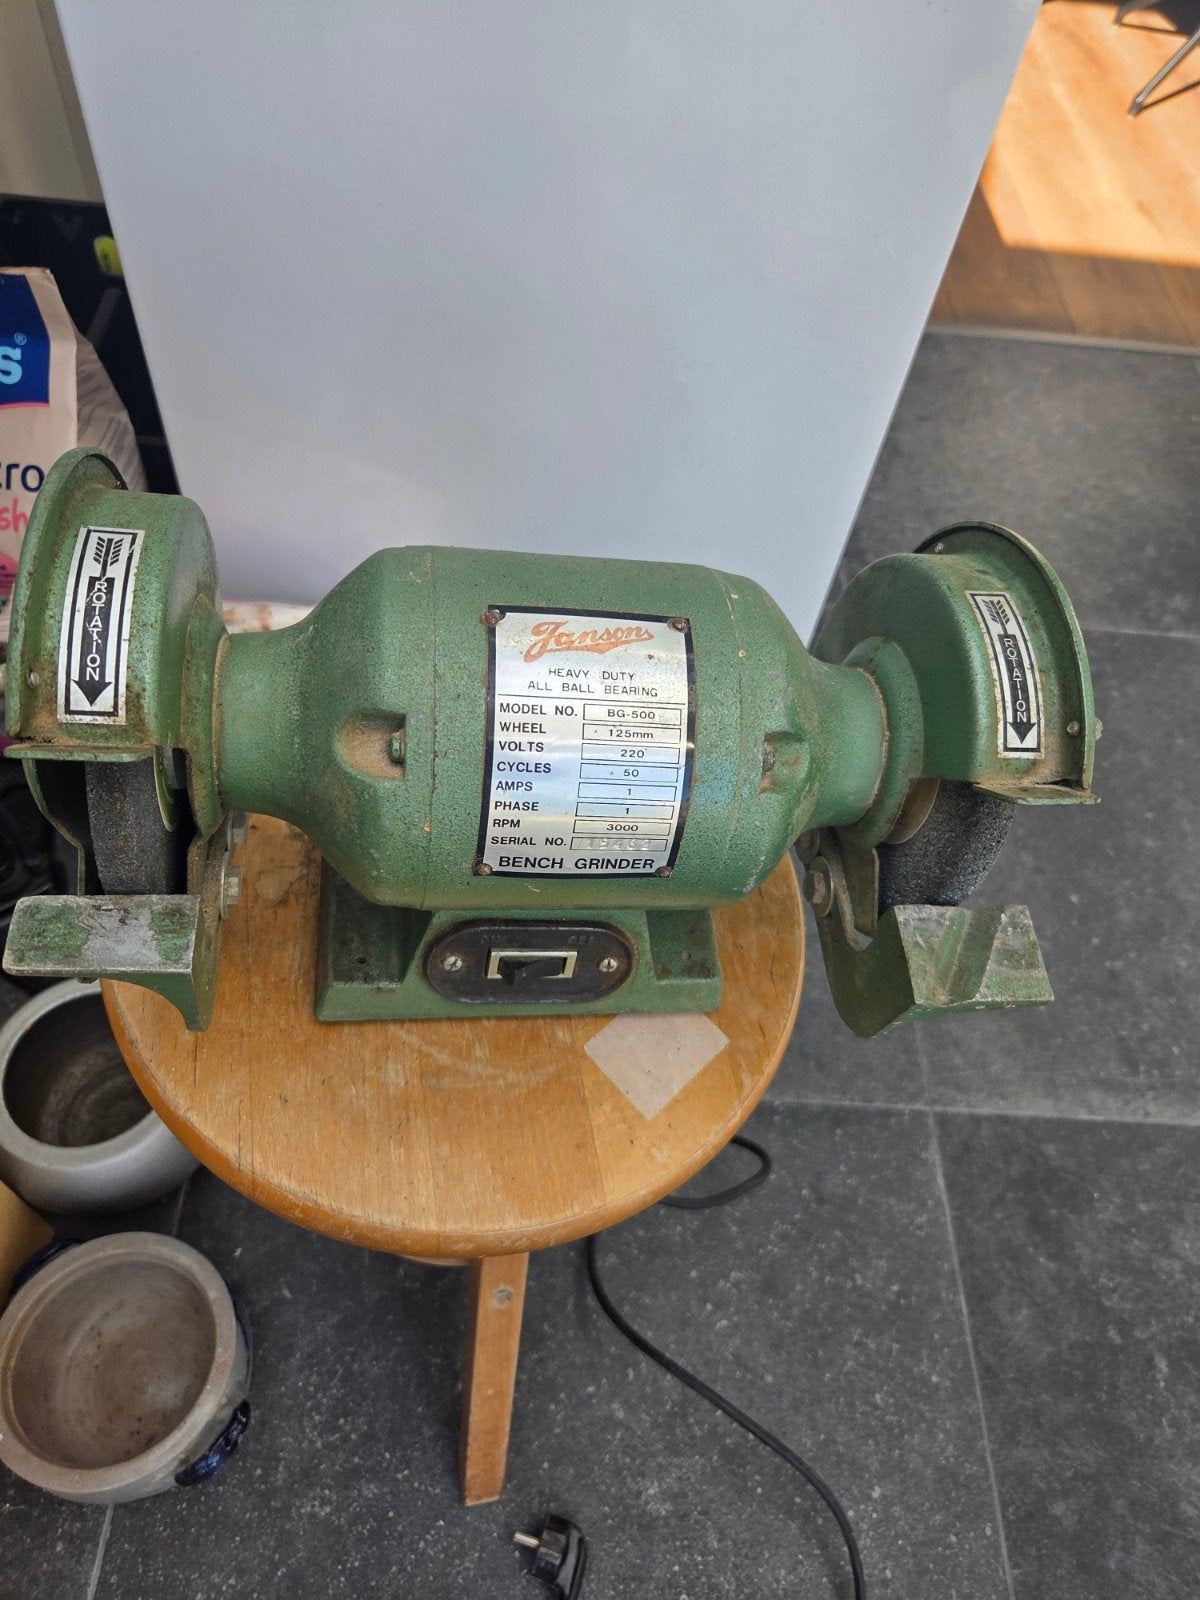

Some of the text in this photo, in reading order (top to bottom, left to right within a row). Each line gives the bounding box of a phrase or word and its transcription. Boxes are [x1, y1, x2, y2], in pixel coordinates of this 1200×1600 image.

[0, 463, 46, 493] ro
[86, 581, 108, 681] ROTATION
[549, 668, 635, 681] HEAVY DUTY
[1003, 638, 1027, 723] ROTATION
[528, 681, 658, 697] ALL BALL BEARING
[499, 703, 655, 719] MODEL NO. BG-500
[499, 722, 654, 739] WHEEL 125mm
[498, 741, 645, 758] VOLTS 220
[497, 761, 639, 777] CYCLES 50
[496, 781, 533, 791] AMPS
[494, 801, 539, 811] PHASE
[492, 819, 639, 832] RPM 3000
[490, 836, 536, 846] SERIAL
[544, 837, 567, 846] NO.
[499, 856, 654, 869] BENCH GRINDER
